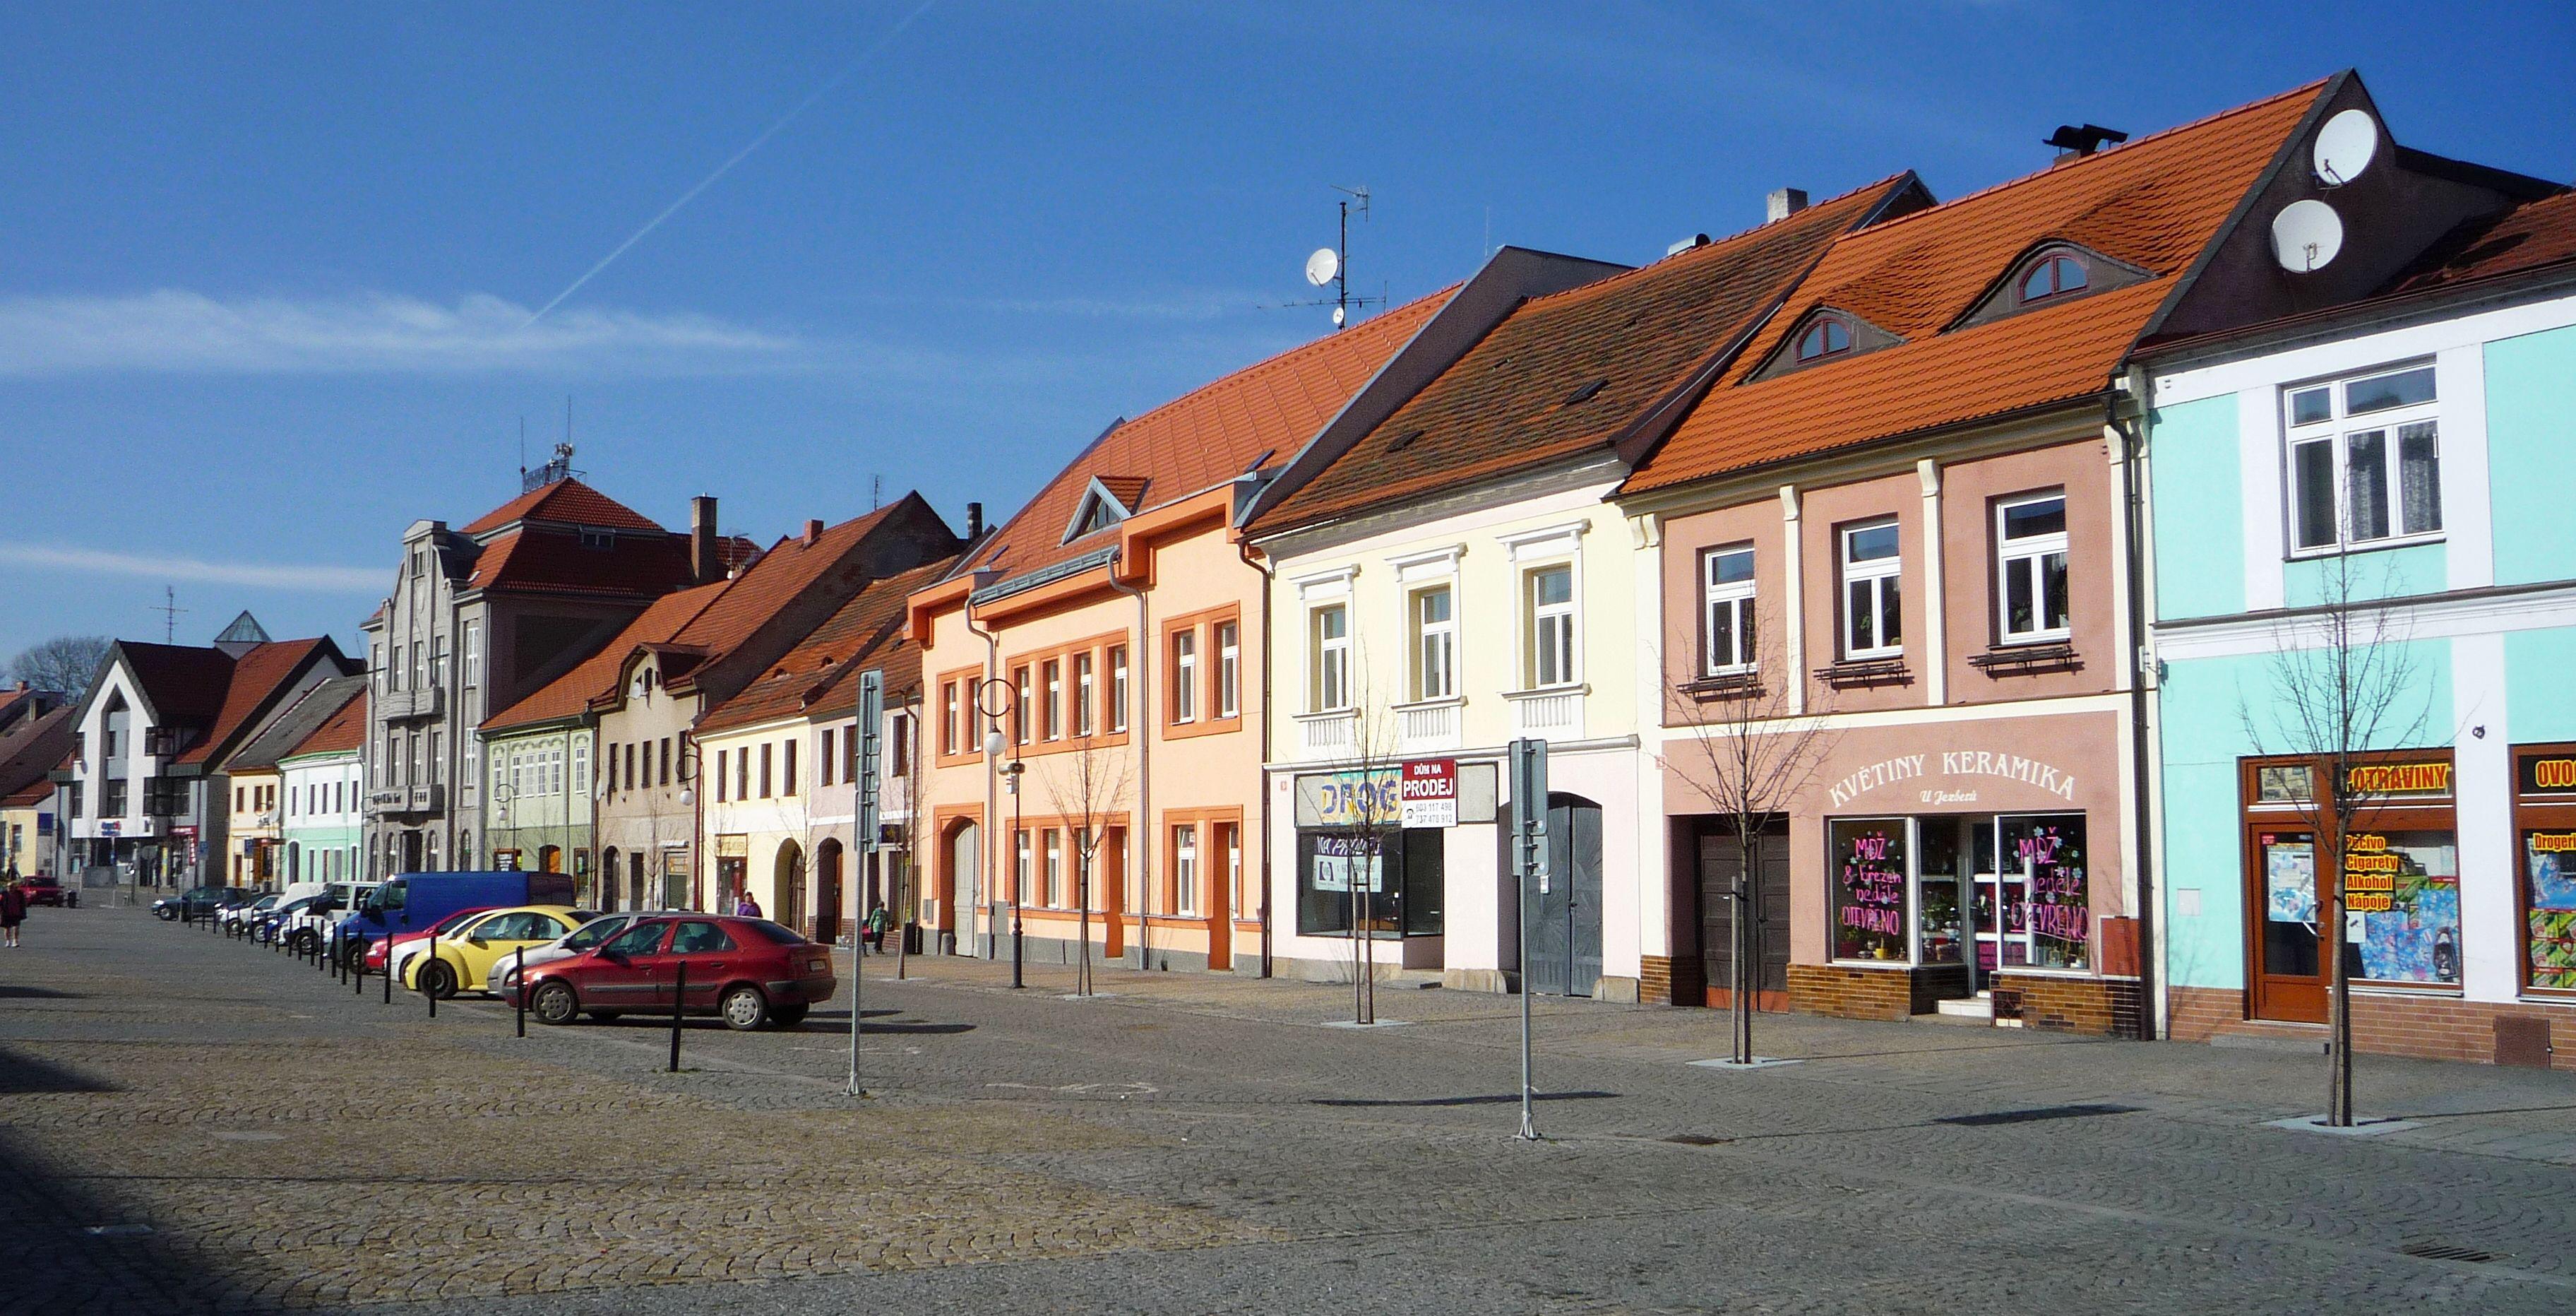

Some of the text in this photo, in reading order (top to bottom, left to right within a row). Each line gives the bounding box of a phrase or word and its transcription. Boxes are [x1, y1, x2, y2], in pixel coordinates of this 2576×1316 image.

[1431, 764, 1442, 774] NA
[2535, 759, 2576, 788] OVO
[1403, 778, 1453, 798] PRODEJ
[1829, 751, 2075, 808] KVĚTINY KERAMIKA
[1919, 790, 1932, 802] U
[2345, 854, 2398, 872] Cigarety
[2345, 874, 2393, 890] Alkohol
[2345, 892, 2391, 911] Nápoje
